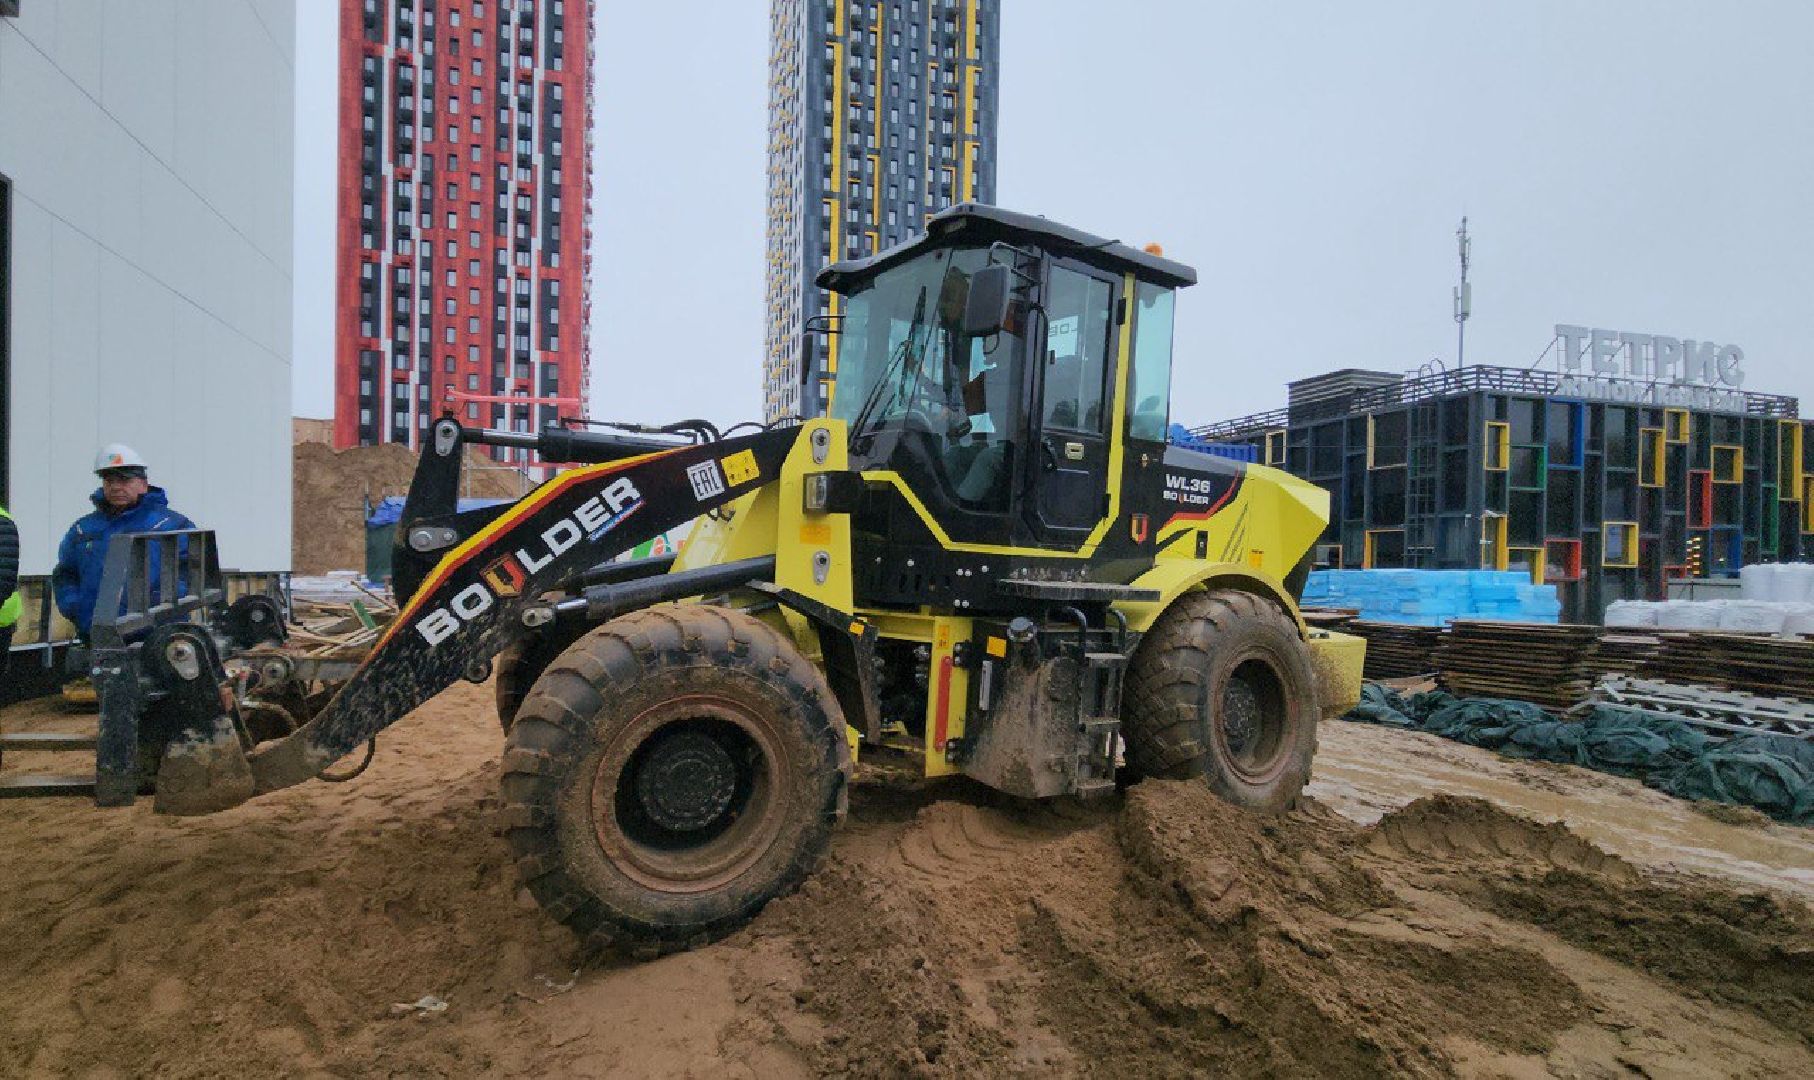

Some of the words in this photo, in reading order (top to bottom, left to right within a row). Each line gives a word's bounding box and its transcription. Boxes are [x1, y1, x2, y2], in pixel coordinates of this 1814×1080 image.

[1555, 324, 1745, 386] ТЕТРИС
[1165, 474, 1211, 493] WL36
[415, 477, 641, 647] BOULDER
